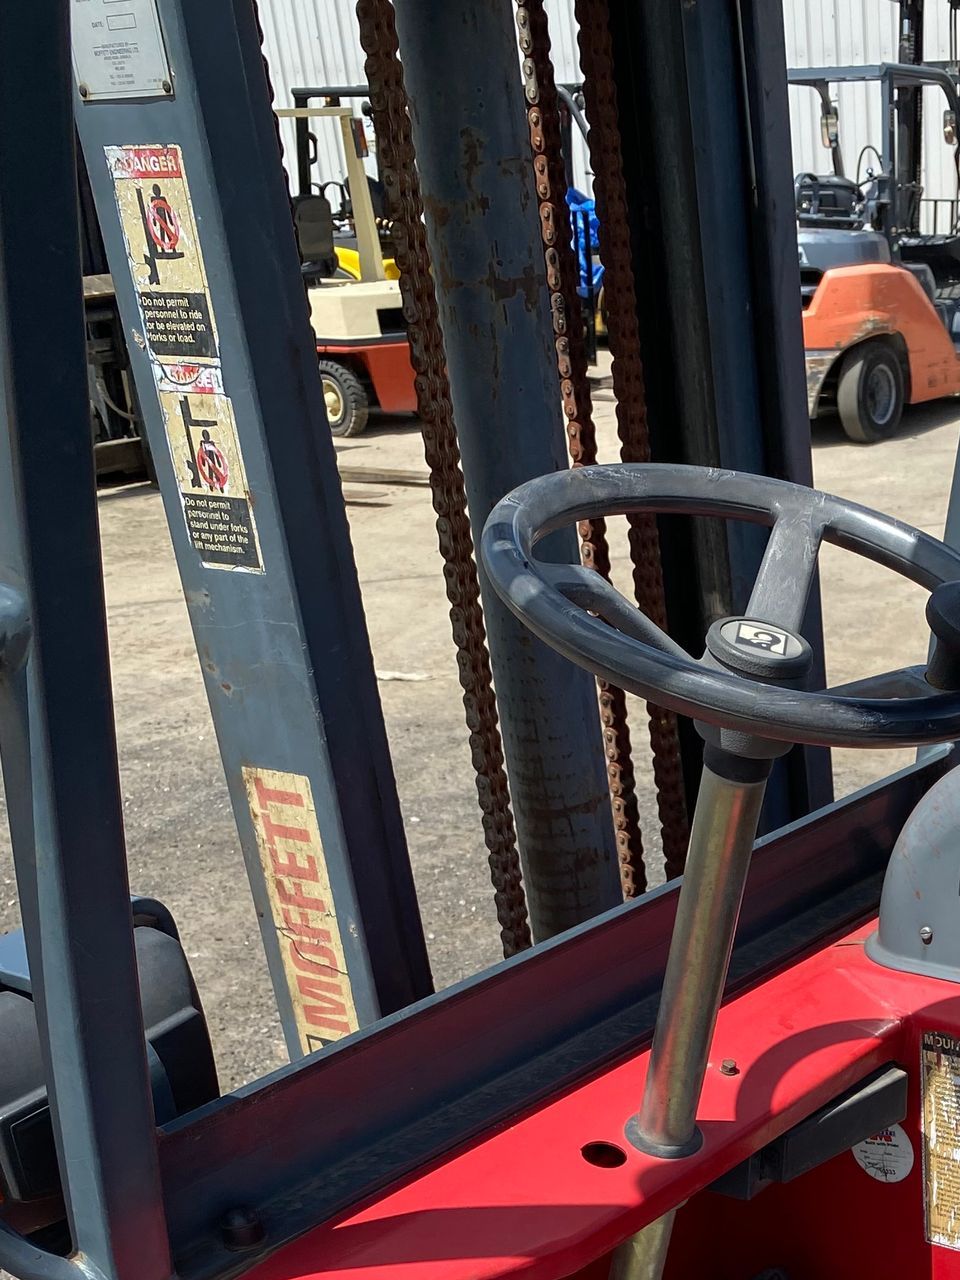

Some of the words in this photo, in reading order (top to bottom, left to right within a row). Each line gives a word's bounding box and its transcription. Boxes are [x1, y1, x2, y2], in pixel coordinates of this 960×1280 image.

[142, 296, 152, 306] Do
[153, 298, 166, 307] not
[166, 297, 190, 308] permit
[144, 310, 179, 320] personnel
[180, 310, 188, 319] to
[188, 310, 202, 320] ride
[156, 321, 165, 330] be
[166, 321, 195, 332] elevated
[196, 324, 206, 332] on
[168, 334, 176, 342] or
[185, 497, 194, 506] Do
[196, 500, 208, 508] not
[208, 501, 231, 510] permit
[188, 510, 221, 520] personnel
[222, 512, 230, 520] to
[190, 520, 208, 530] stand
[210, 522, 229, 531] under
[230, 524, 248, 534] forks
[201, 532, 213, 542] any
[214, 533, 228, 542] part
[229, 534, 236, 542] of
[238, 534, 248, 544] the
[253, 776, 350, 1034] MOFFETT
